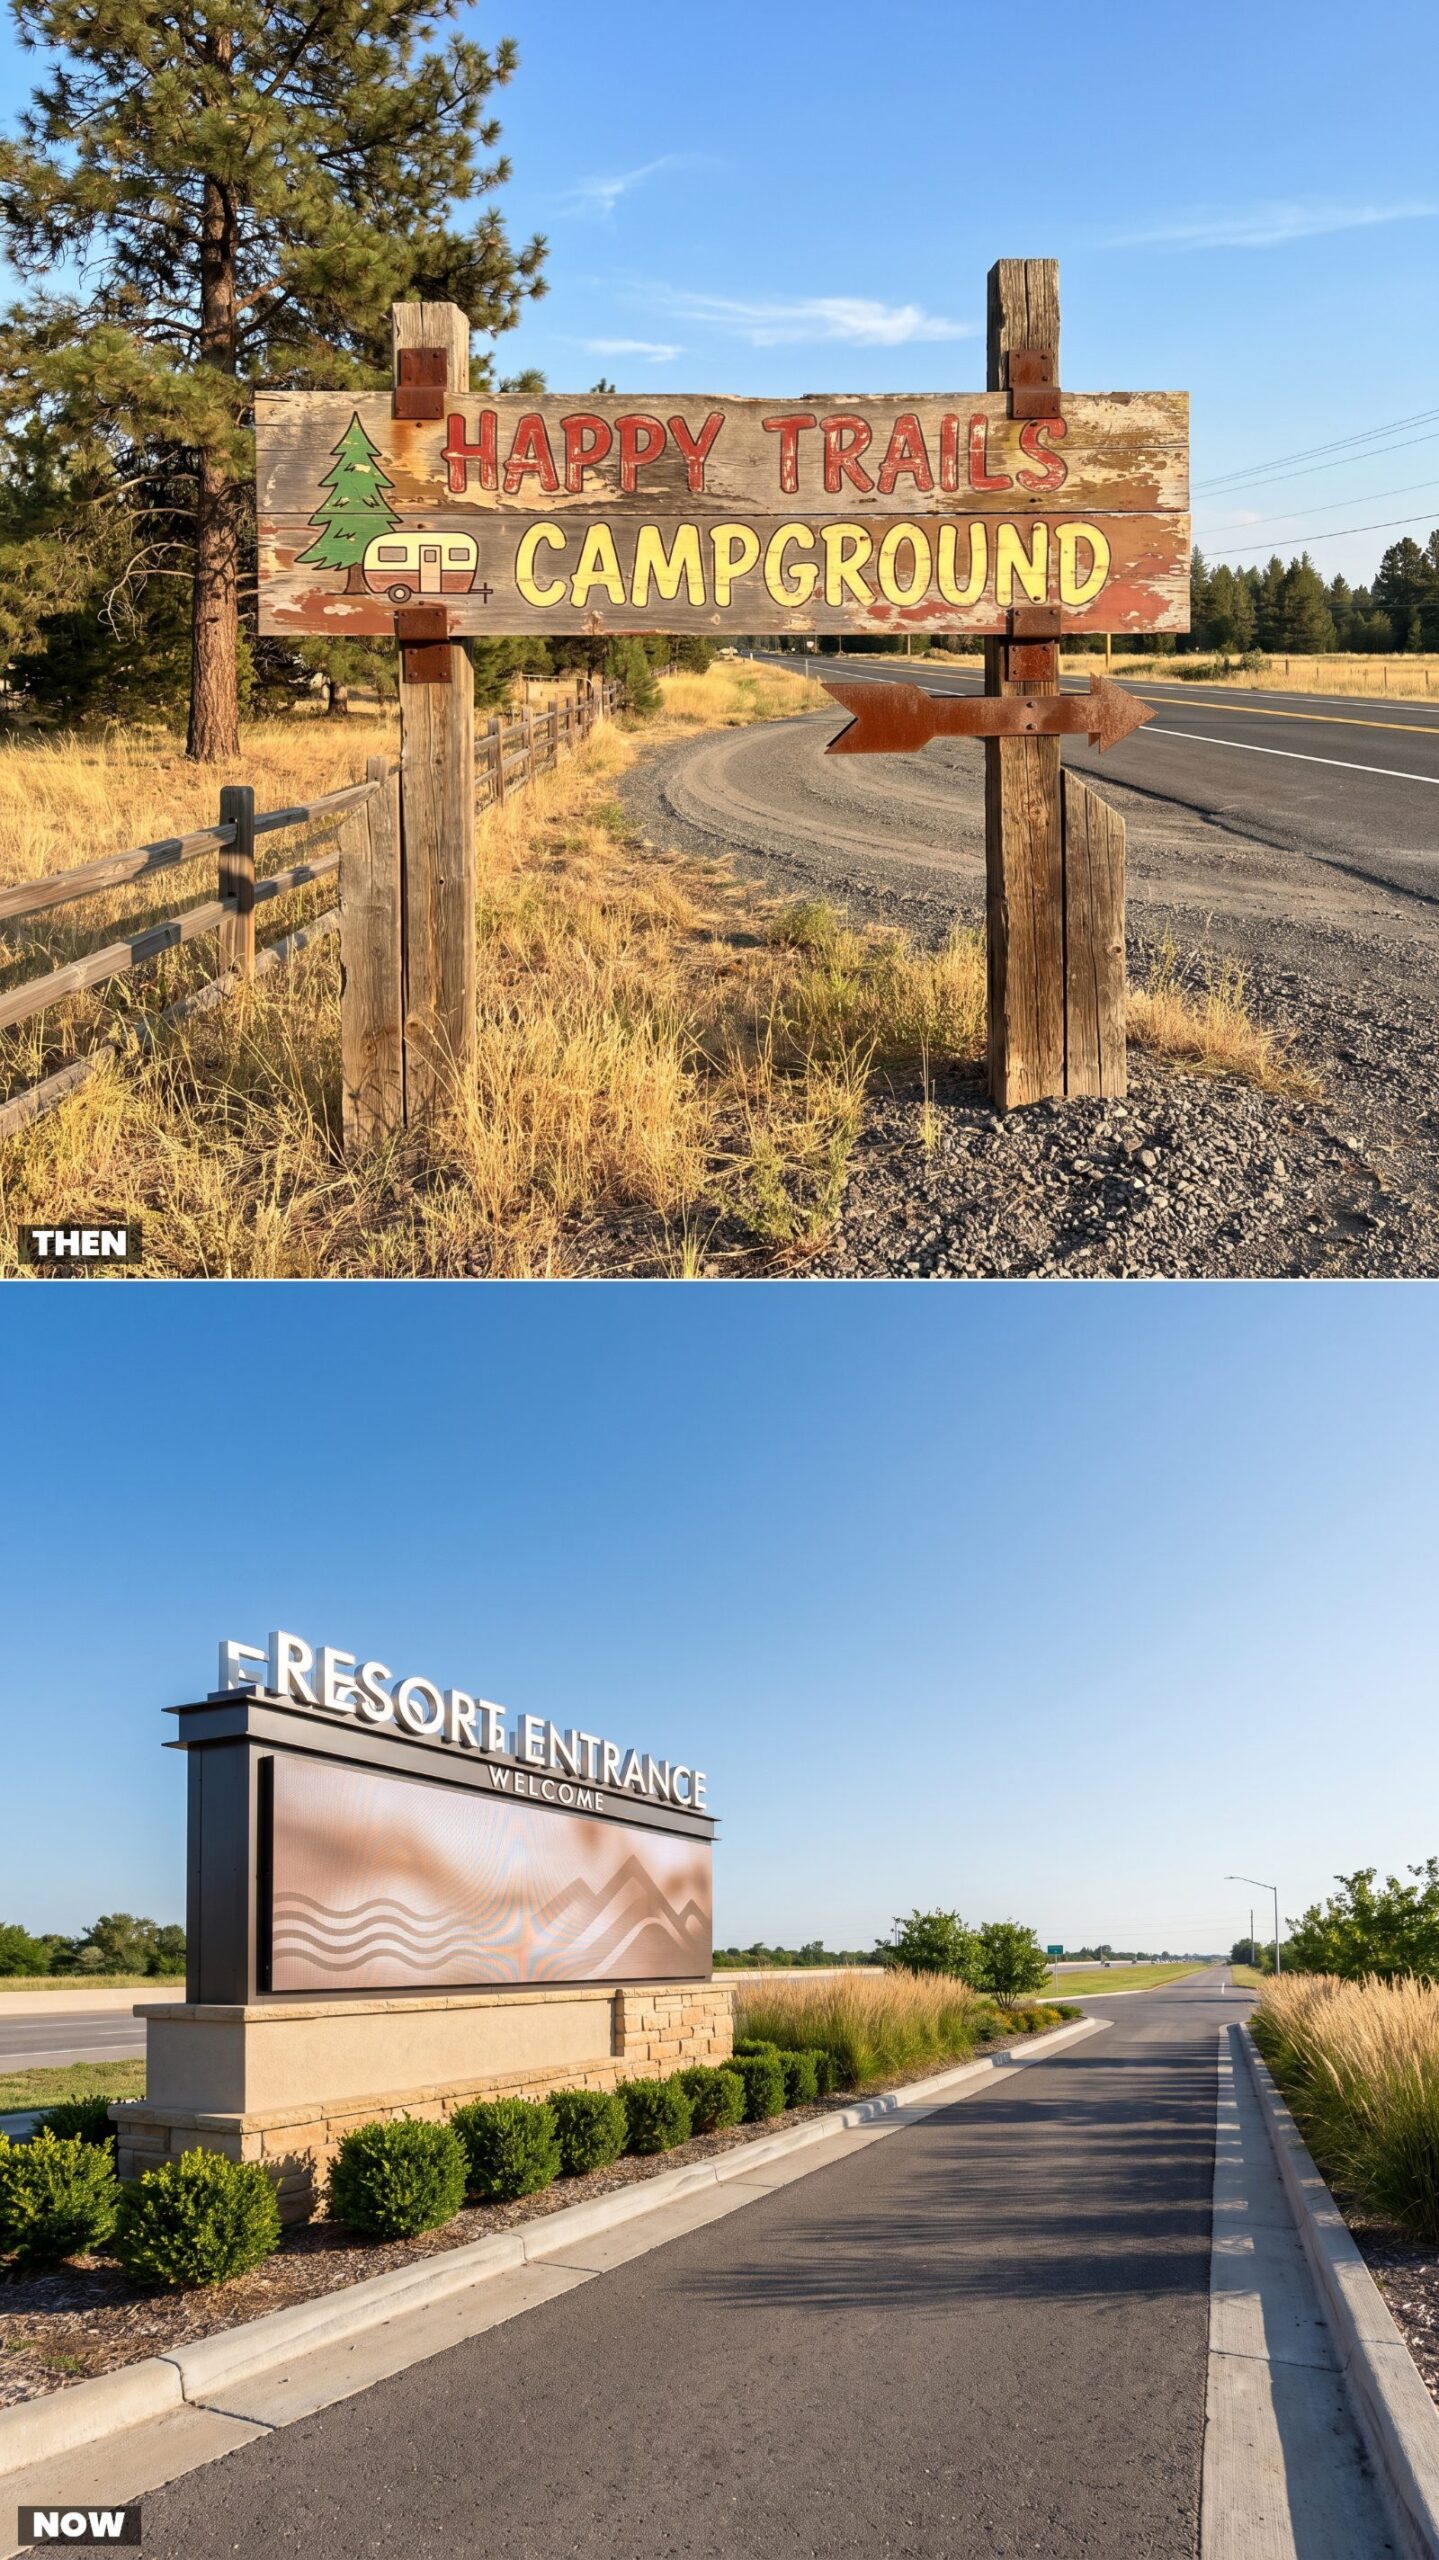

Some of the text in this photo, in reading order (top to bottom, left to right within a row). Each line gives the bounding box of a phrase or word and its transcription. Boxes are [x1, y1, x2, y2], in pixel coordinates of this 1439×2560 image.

[441, 410, 1068, 494] HAPPY TRAILS
[514, 521, 1111, 607] CAMPGROUND
[268, 1630, 505, 1752] RESORT
[517, 1713, 707, 1809] ENTRANCE
[487, 1764, 604, 1811] WELCOME
